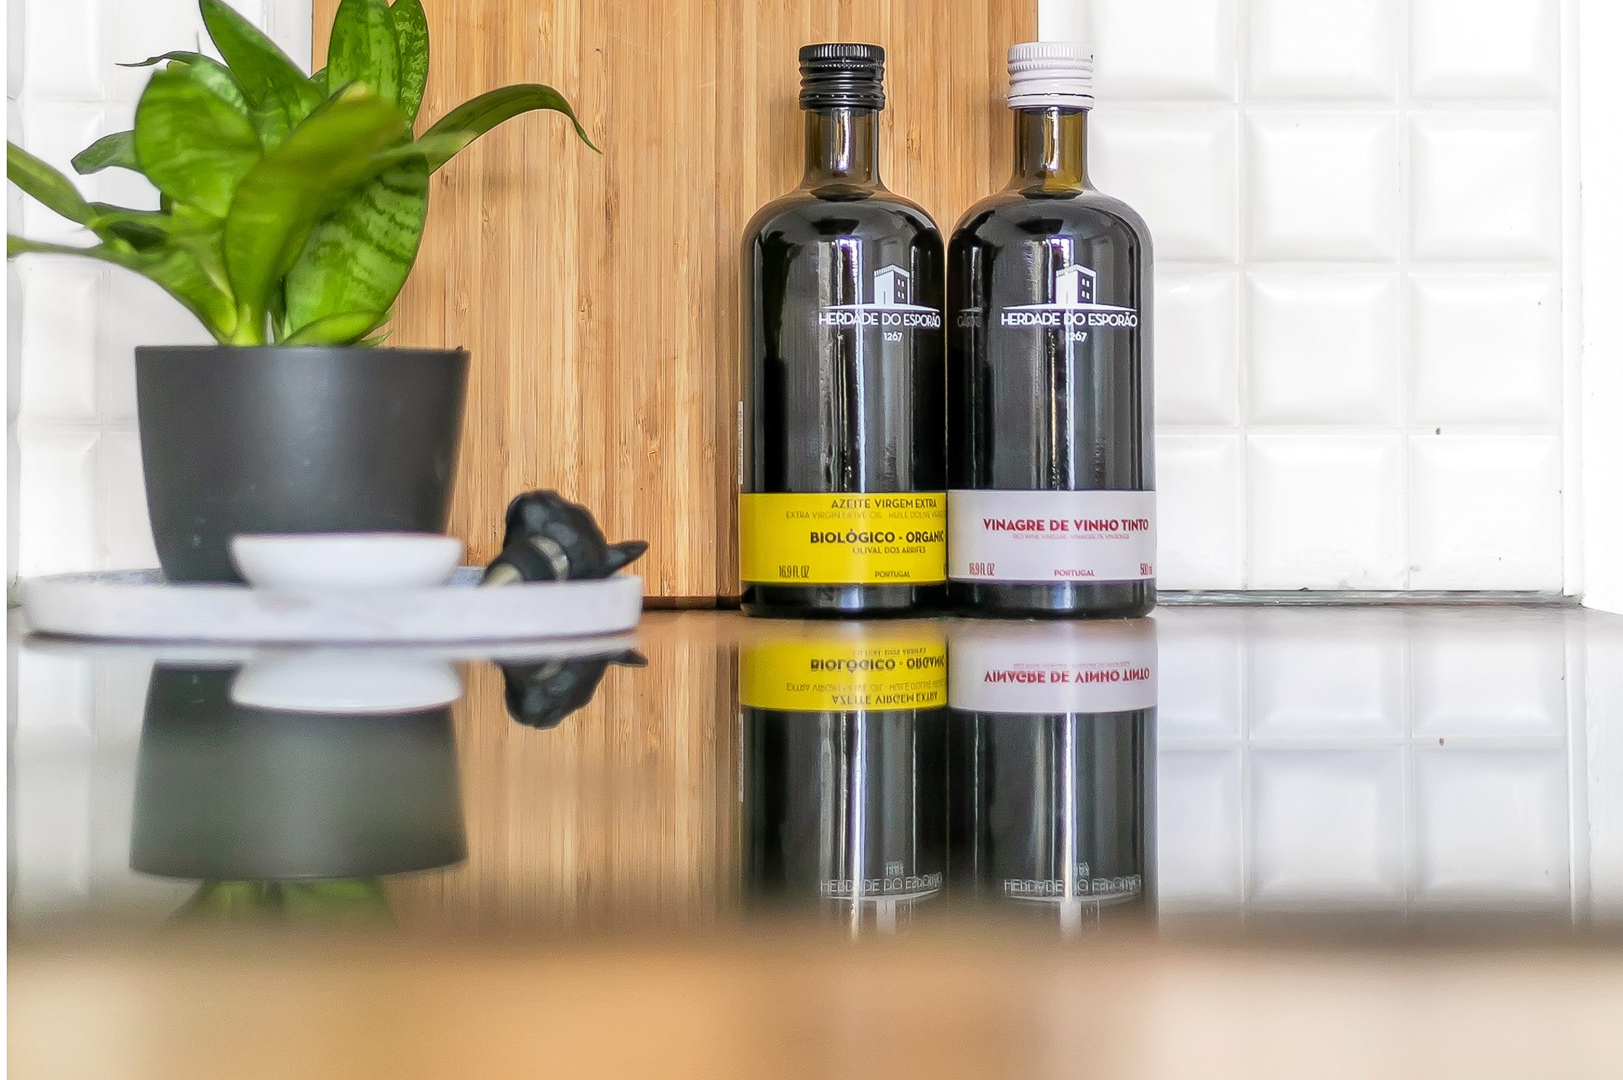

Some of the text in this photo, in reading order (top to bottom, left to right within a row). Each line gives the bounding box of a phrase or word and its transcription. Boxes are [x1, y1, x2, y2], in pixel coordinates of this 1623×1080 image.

[818, 312, 879, 326] HERDADE
[881, 312, 902, 326] DO
[903, 311, 941, 328] ESPORÃO
[1000, 310, 1138, 328] HERDADE DO ESPORÃO
[883, 331, 904, 342] 1267
[831, 498, 937, 509] AZEITE VIRGEM EXTRA
[785, 510, 810, 520] EXTRA
[982, 517, 1150, 532] VINAGRE DE VINHO TINTO
[810, 528, 896, 544] BIOLÓGICO
[884, 546, 901, 554] DOS
[875, 570, 911, 578] PORTUGAL
[1054, 569, 1096, 577] PORTUGAL
